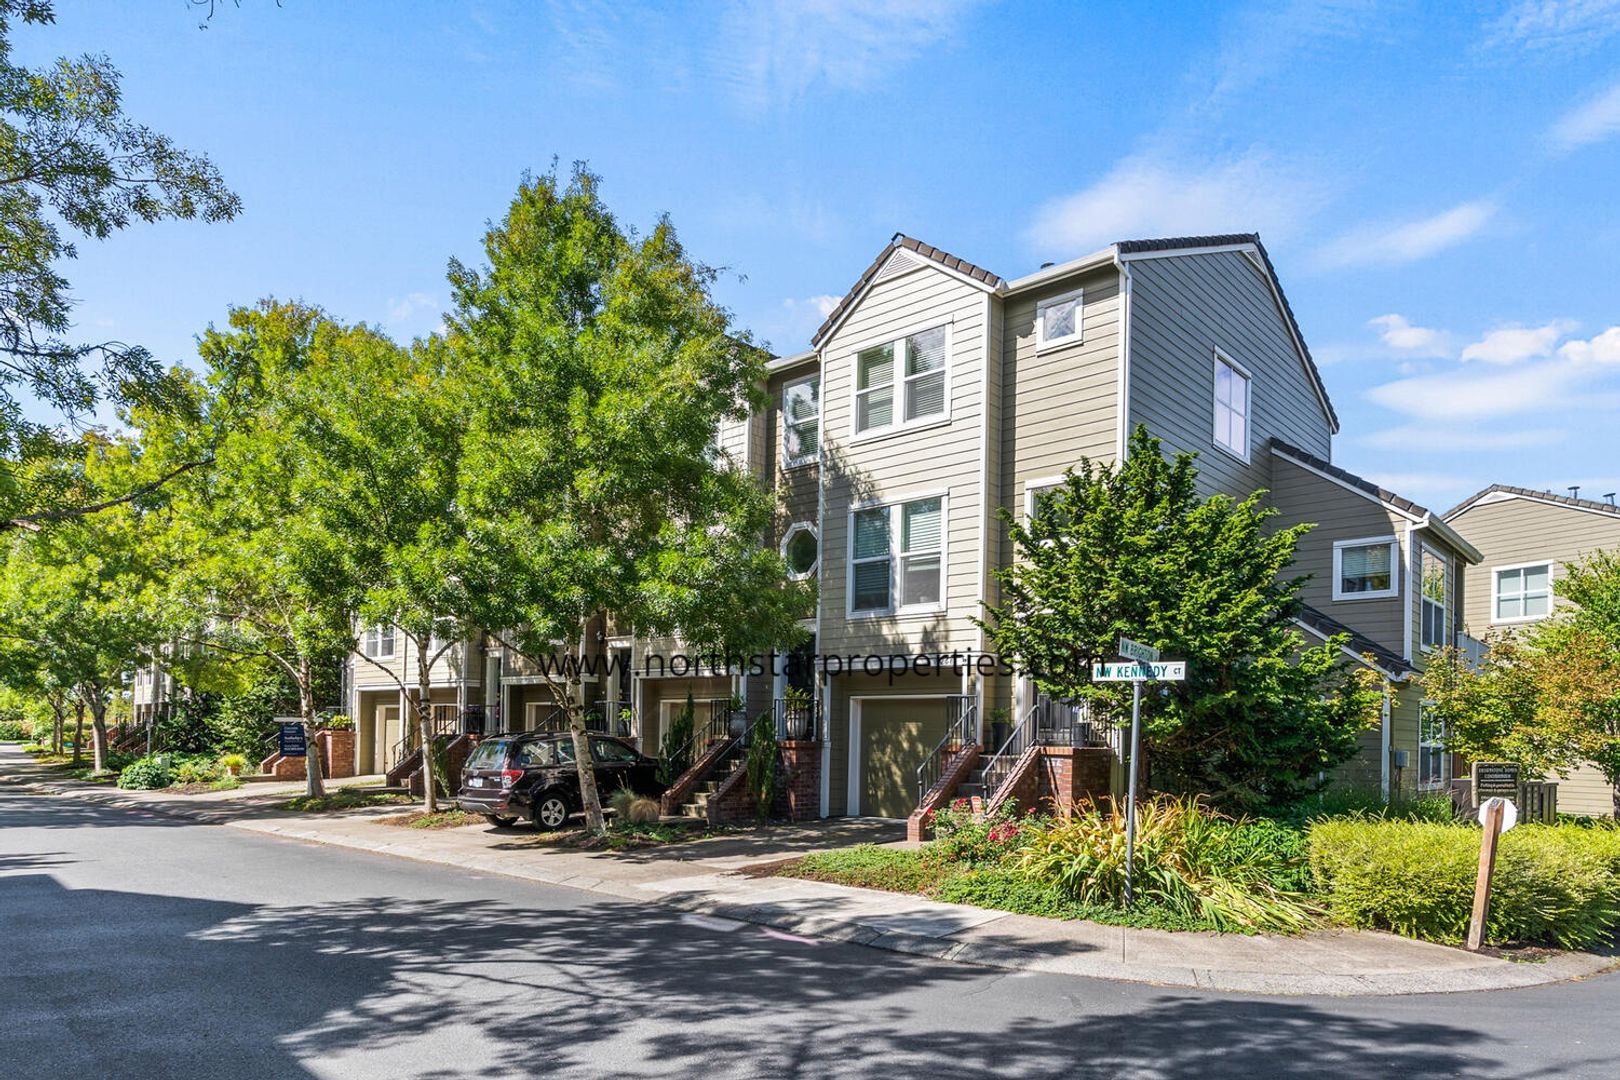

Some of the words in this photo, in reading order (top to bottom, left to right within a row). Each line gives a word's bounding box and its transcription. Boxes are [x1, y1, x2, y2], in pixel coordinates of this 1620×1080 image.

[1096, 666, 1112, 678] NW
[1117, 665, 1168, 678] KENNEDY
[1173, 667, 1181, 675] CT
